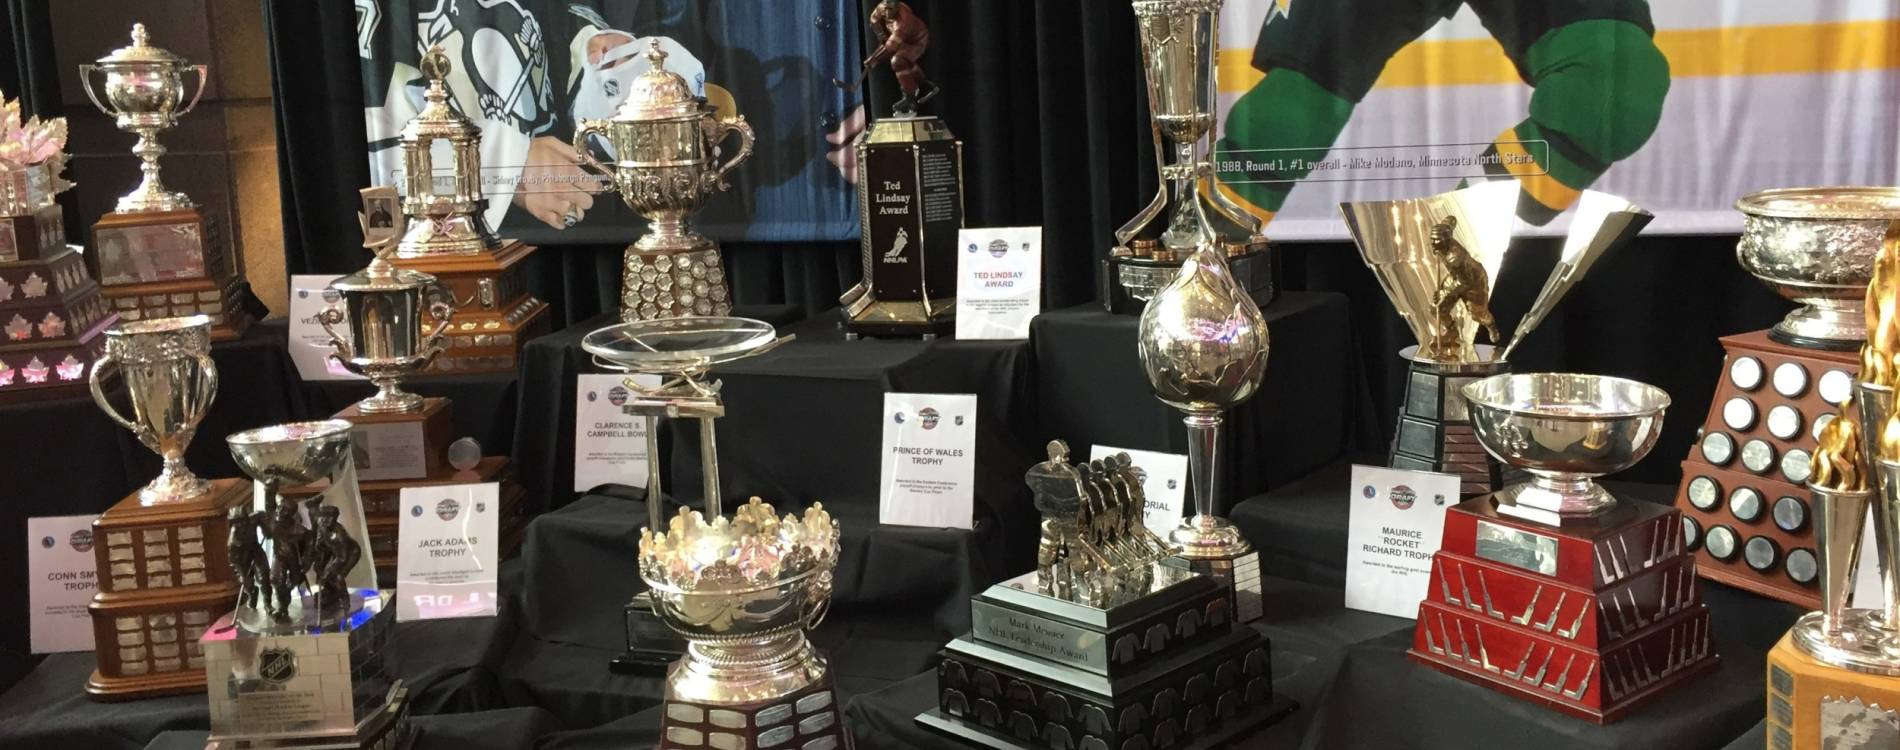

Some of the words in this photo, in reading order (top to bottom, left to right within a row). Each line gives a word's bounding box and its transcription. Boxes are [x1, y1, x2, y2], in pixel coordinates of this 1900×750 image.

[1216, 161, 1244, 173] 1988,
[1245, 160, 1276, 172] Round
[1278, 159, 1288, 171] 1,
[1289, 158, 1304, 170] #1
[1306, 158, 1340, 170] overall
[1350, 157, 1372, 169] Mike
[1374, 155, 1416, 169] Modano,
[1418, 154, 1472, 168] Minnesota
[1474, 153, 1501, 165] North
[1503, 152, 1536, 164] Stars
[883, 180, 901, 191] Ted
[875, 193, 911, 204] Lindsay
[879, 205, 909, 215] Award
[974, 271, 989, 280] TED
[990, 271, 1024, 280] LINDSAY
[984, 280, 1015, 289] AWARD
[594, 422, 632, 430] CLARENCE
[586, 430, 627, 438] CAMPBELL
[892, 446, 921, 455] PRINCE
[922, 447, 934, 456] OF
[935, 448, 964, 457] WALES
[911, 457, 944, 466] TROPHY
[1381, 526, 1423, 539] MAURICE
[418, 539, 443, 549] JACK
[429, 548, 467, 558] TROPHY
[1362, 543, 1402, 557] RICHARD
[1403, 549, 1434, 561] TROPH
[47, 572, 77, 581] CONN
[1008, 617, 1030, 630] Mark
[988, 625, 1006, 638] NHL
[1059, 646, 1089, 662] Award
[266, 657, 290, 677] NHL
